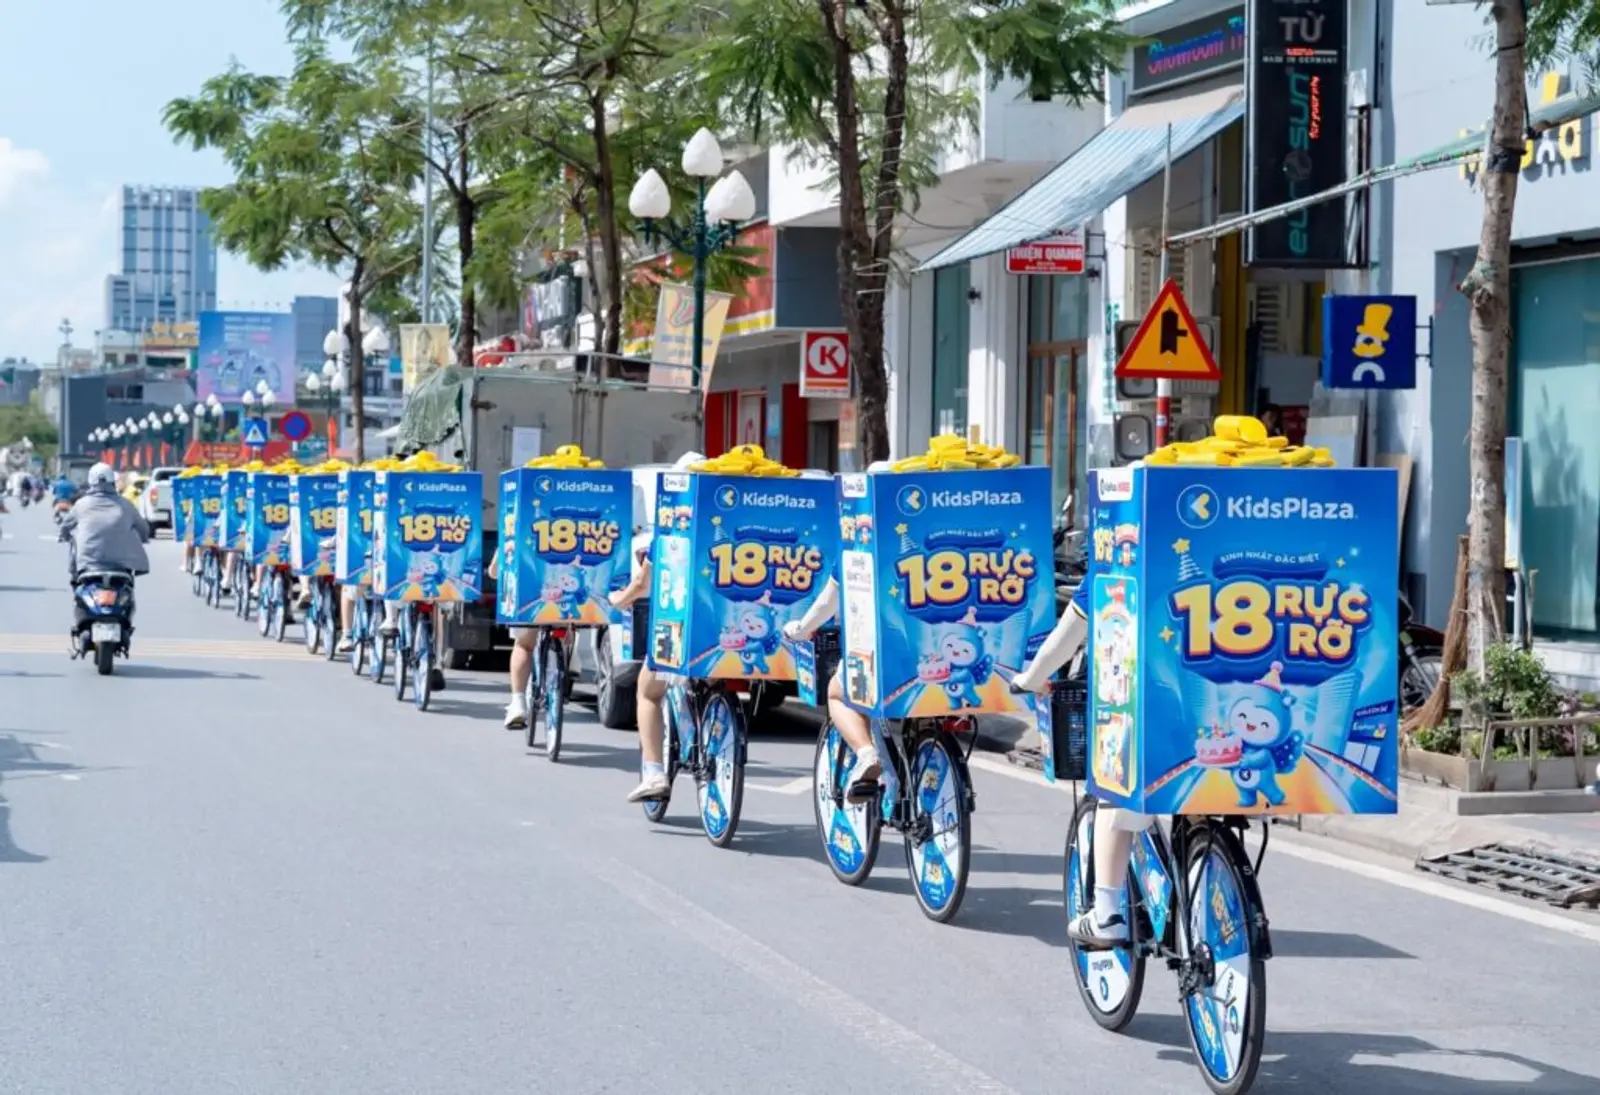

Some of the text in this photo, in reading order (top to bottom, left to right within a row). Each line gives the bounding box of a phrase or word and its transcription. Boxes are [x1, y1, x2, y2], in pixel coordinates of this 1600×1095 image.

[1279, 10, 1325, 42] TỪ
[556, 480, 614, 493] KidsPlaza
[743, 491, 816, 509] KidsPlaza
[931, 490, 1022, 508] KidsPlaza
[1227, 496, 1355, 520] KidsPlaza
[263, 504, 289, 523] 18
[310, 507, 337, 530] 18
[359, 509, 373, 532] 1
[399, 514, 436, 542] 18
[533, 518, 577, 552] 18
[711, 542, 822, 586] 18 RỰC
[898, 551, 969, 606] 18
[969, 550, 1033, 579] RỰC
[1173, 581, 1368, 658] 18 RỰC
